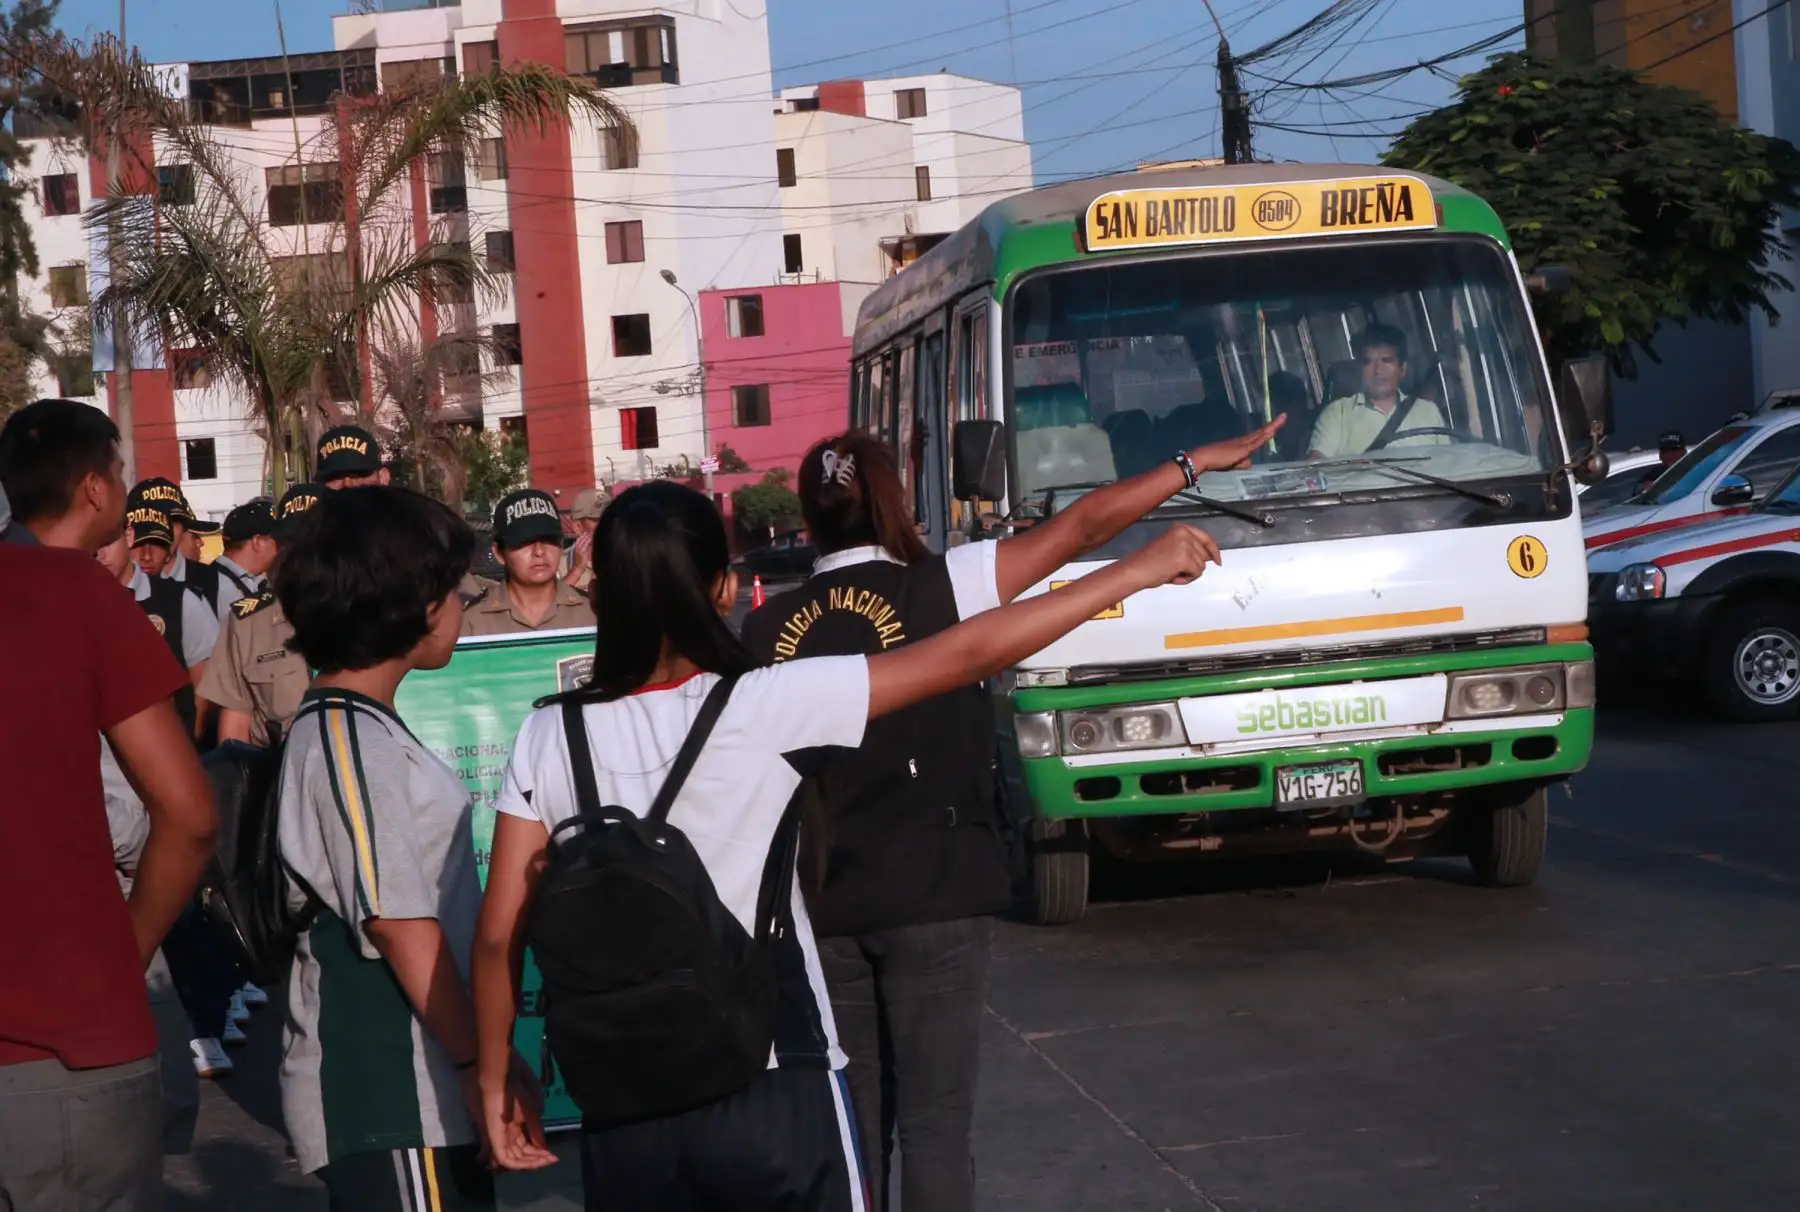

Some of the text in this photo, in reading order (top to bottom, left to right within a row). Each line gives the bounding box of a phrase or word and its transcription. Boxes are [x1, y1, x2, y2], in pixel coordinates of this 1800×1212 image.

[1096, 195, 1236, 240] SAN BARTOLO
[1320, 183, 1414, 227] BREÑA
[320, 436, 367, 460] POLICIA
[127, 508, 170, 530] POLICIA
[282, 495, 318, 519] POLIC
[506, 497, 558, 526] POLICIA
[1519, 541, 1535, 572] 6
[829, 586, 905, 649] NACIONAL
[1280, 770, 1360, 801] Y1G-756
